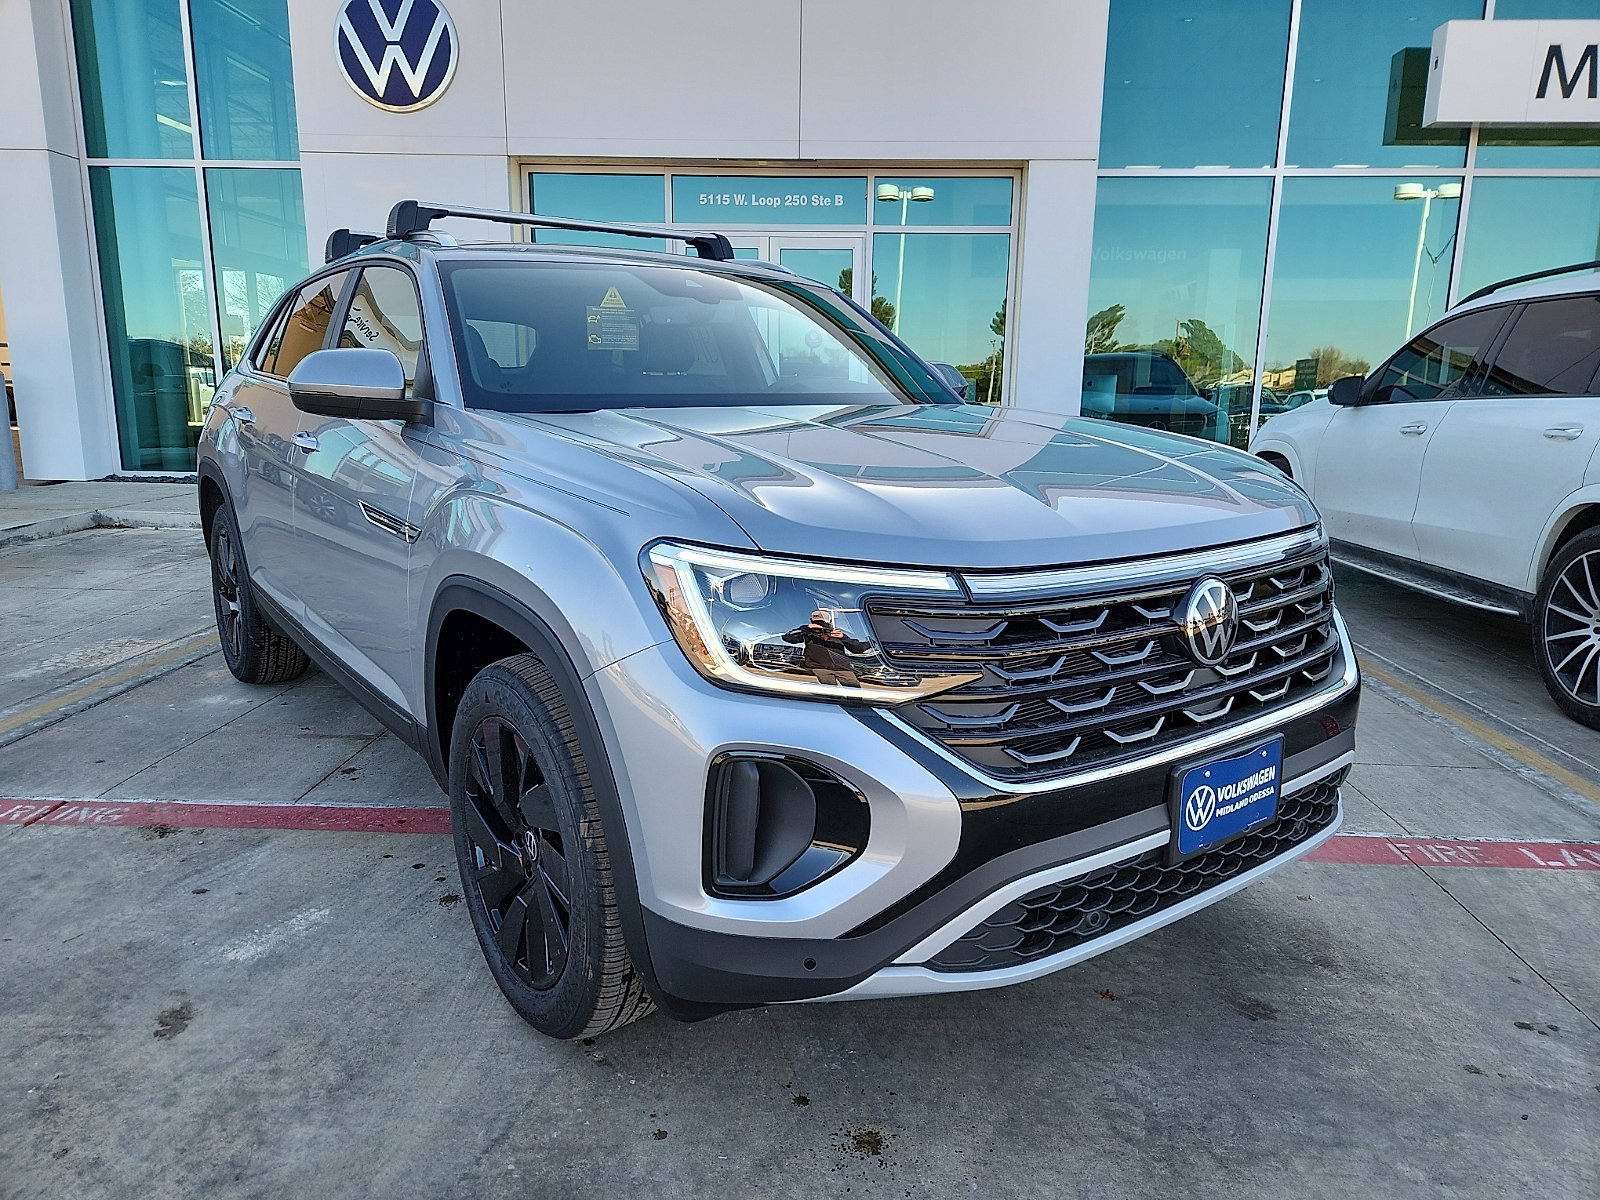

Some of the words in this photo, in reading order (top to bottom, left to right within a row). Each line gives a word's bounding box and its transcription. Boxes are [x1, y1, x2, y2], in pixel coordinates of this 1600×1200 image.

[1536, 44, 1598, 99] M
[699, 193, 730, 205] 5115
[733, 194, 748, 206] W.
[751, 194, 781, 207] Loop
[784, 195, 808, 206] 250
[811, 195, 831, 206] Ste
[834, 195, 844, 206] B
[1217, 765, 1276, 802] VOLKSWAGEN
[1215, 797, 1249, 818] MIDLAND
[1248, 786, 1275, 804] ODESSA
[1386, 843, 1499, 865] FIRE
